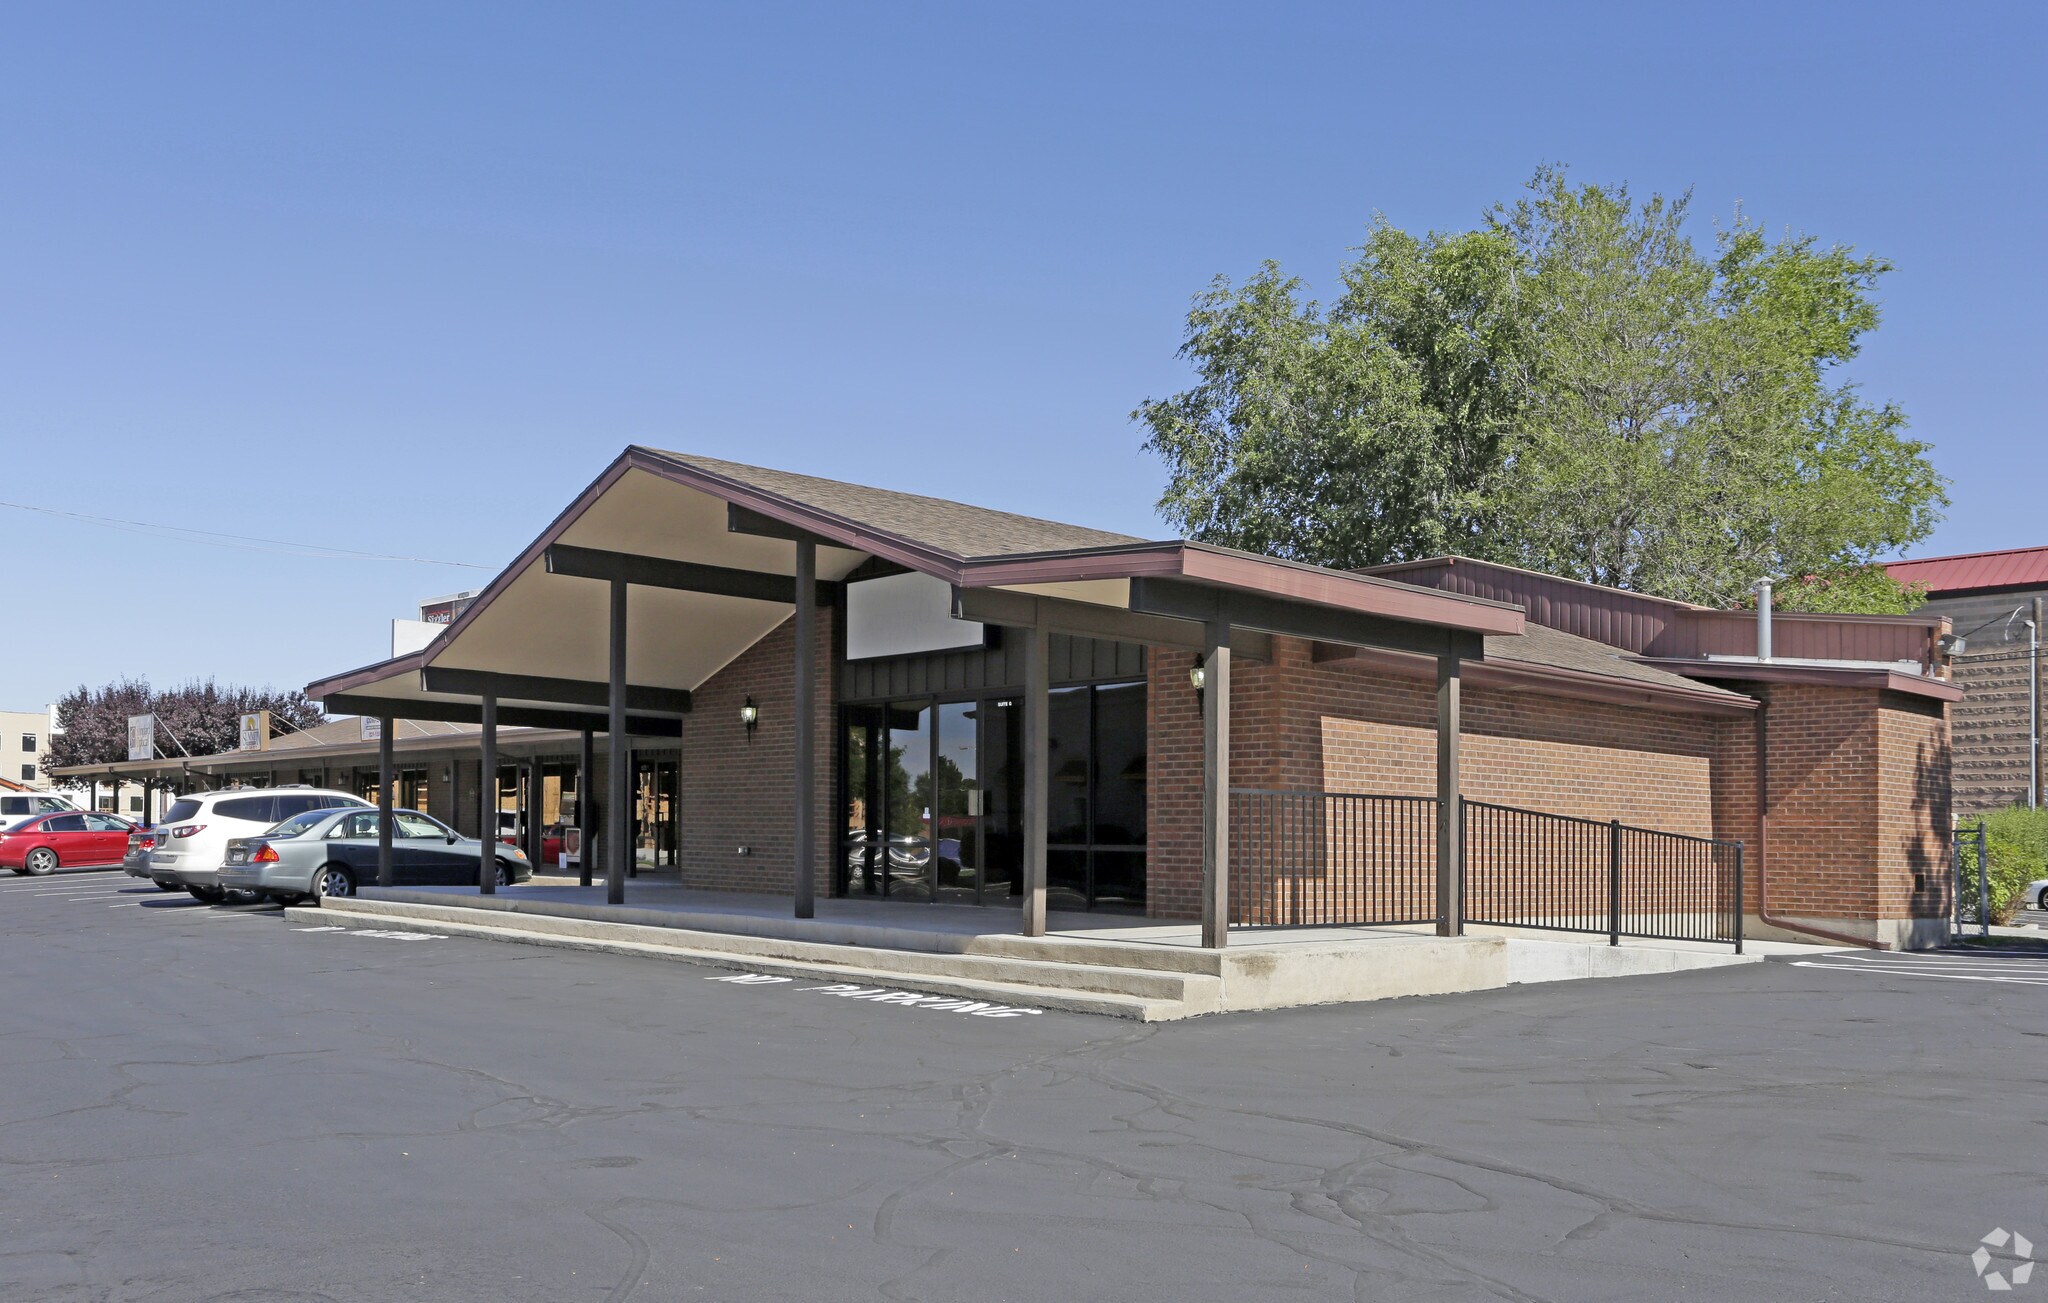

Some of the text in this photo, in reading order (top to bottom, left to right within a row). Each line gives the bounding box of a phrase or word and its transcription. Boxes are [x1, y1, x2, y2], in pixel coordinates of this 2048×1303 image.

[427, 613, 450, 623] Sizzler
[704, 973, 1043, 1018] NO PARKING
